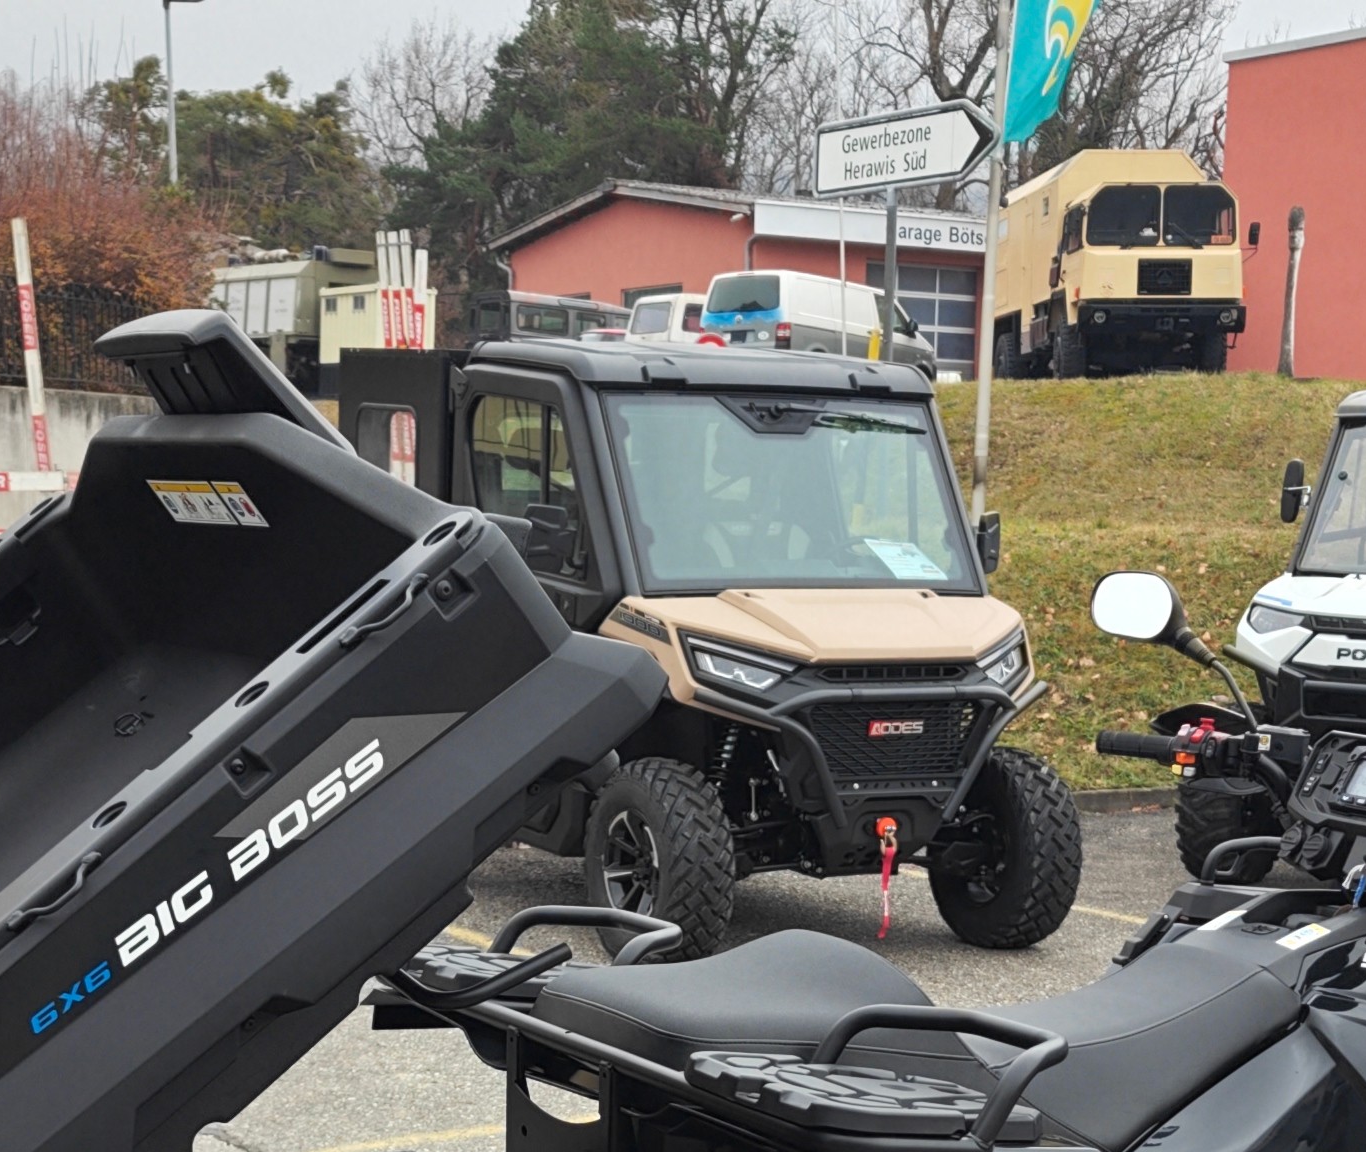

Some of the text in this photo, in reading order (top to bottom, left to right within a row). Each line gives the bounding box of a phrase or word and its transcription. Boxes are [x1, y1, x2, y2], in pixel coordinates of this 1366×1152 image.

[842, 126, 932, 154] Gewerbezone
[844, 149, 927, 181] Herawis Süd
[898, 226, 987, 245] arage Böts
[18, 288, 35, 346] FOSER
[114, 870, 213, 968] BIG
[227, 738, 384, 882] BOSS
